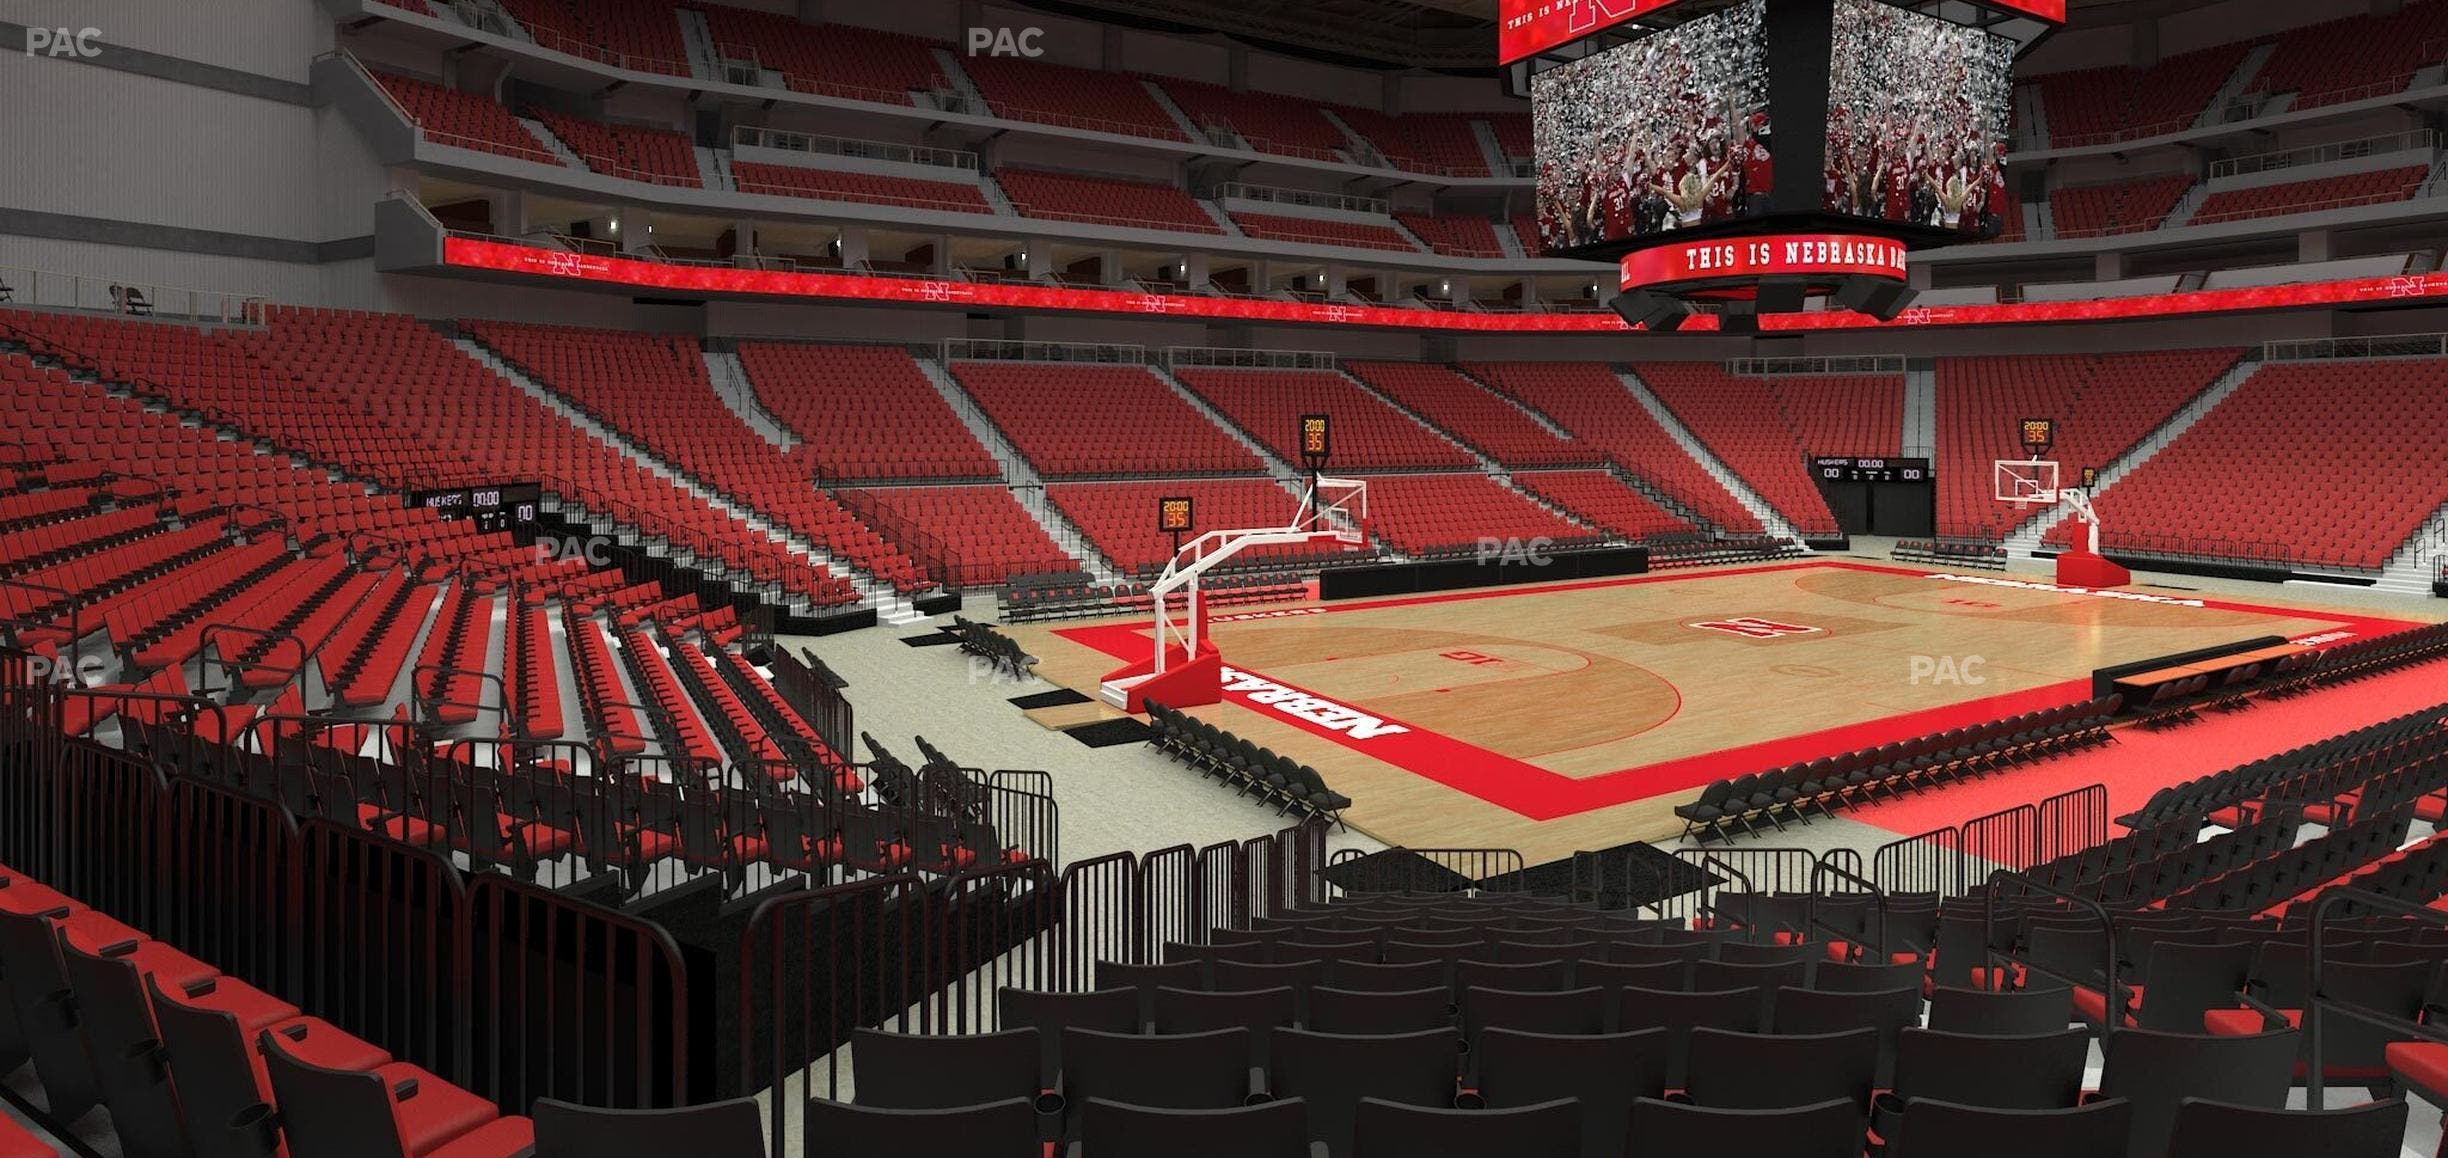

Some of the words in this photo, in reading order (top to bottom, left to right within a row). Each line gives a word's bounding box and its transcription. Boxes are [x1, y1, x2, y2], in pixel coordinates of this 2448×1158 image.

[1507, 12, 1533, 29] THIS
[1538, 6, 1550, 17] IS
[1613, 196, 1624, 211] 31
[1686, 246, 1735, 270] THIS
[1749, 243, 1771, 265] IS
[1785, 241, 1885, 266] NEBRASKA
[1305, 419, 1325, 432] 20:00
[2024, 421, 2049, 430] 20:00
[1308, 433, 1322, 450] 35
[2028, 431, 2045, 442] 35
[1824, 468, 1839, 478] 00
[1903, 469, 1920, 479] 00
[1164, 501, 1189, 512] 20:00
[1168, 512, 1185, 526] 35
